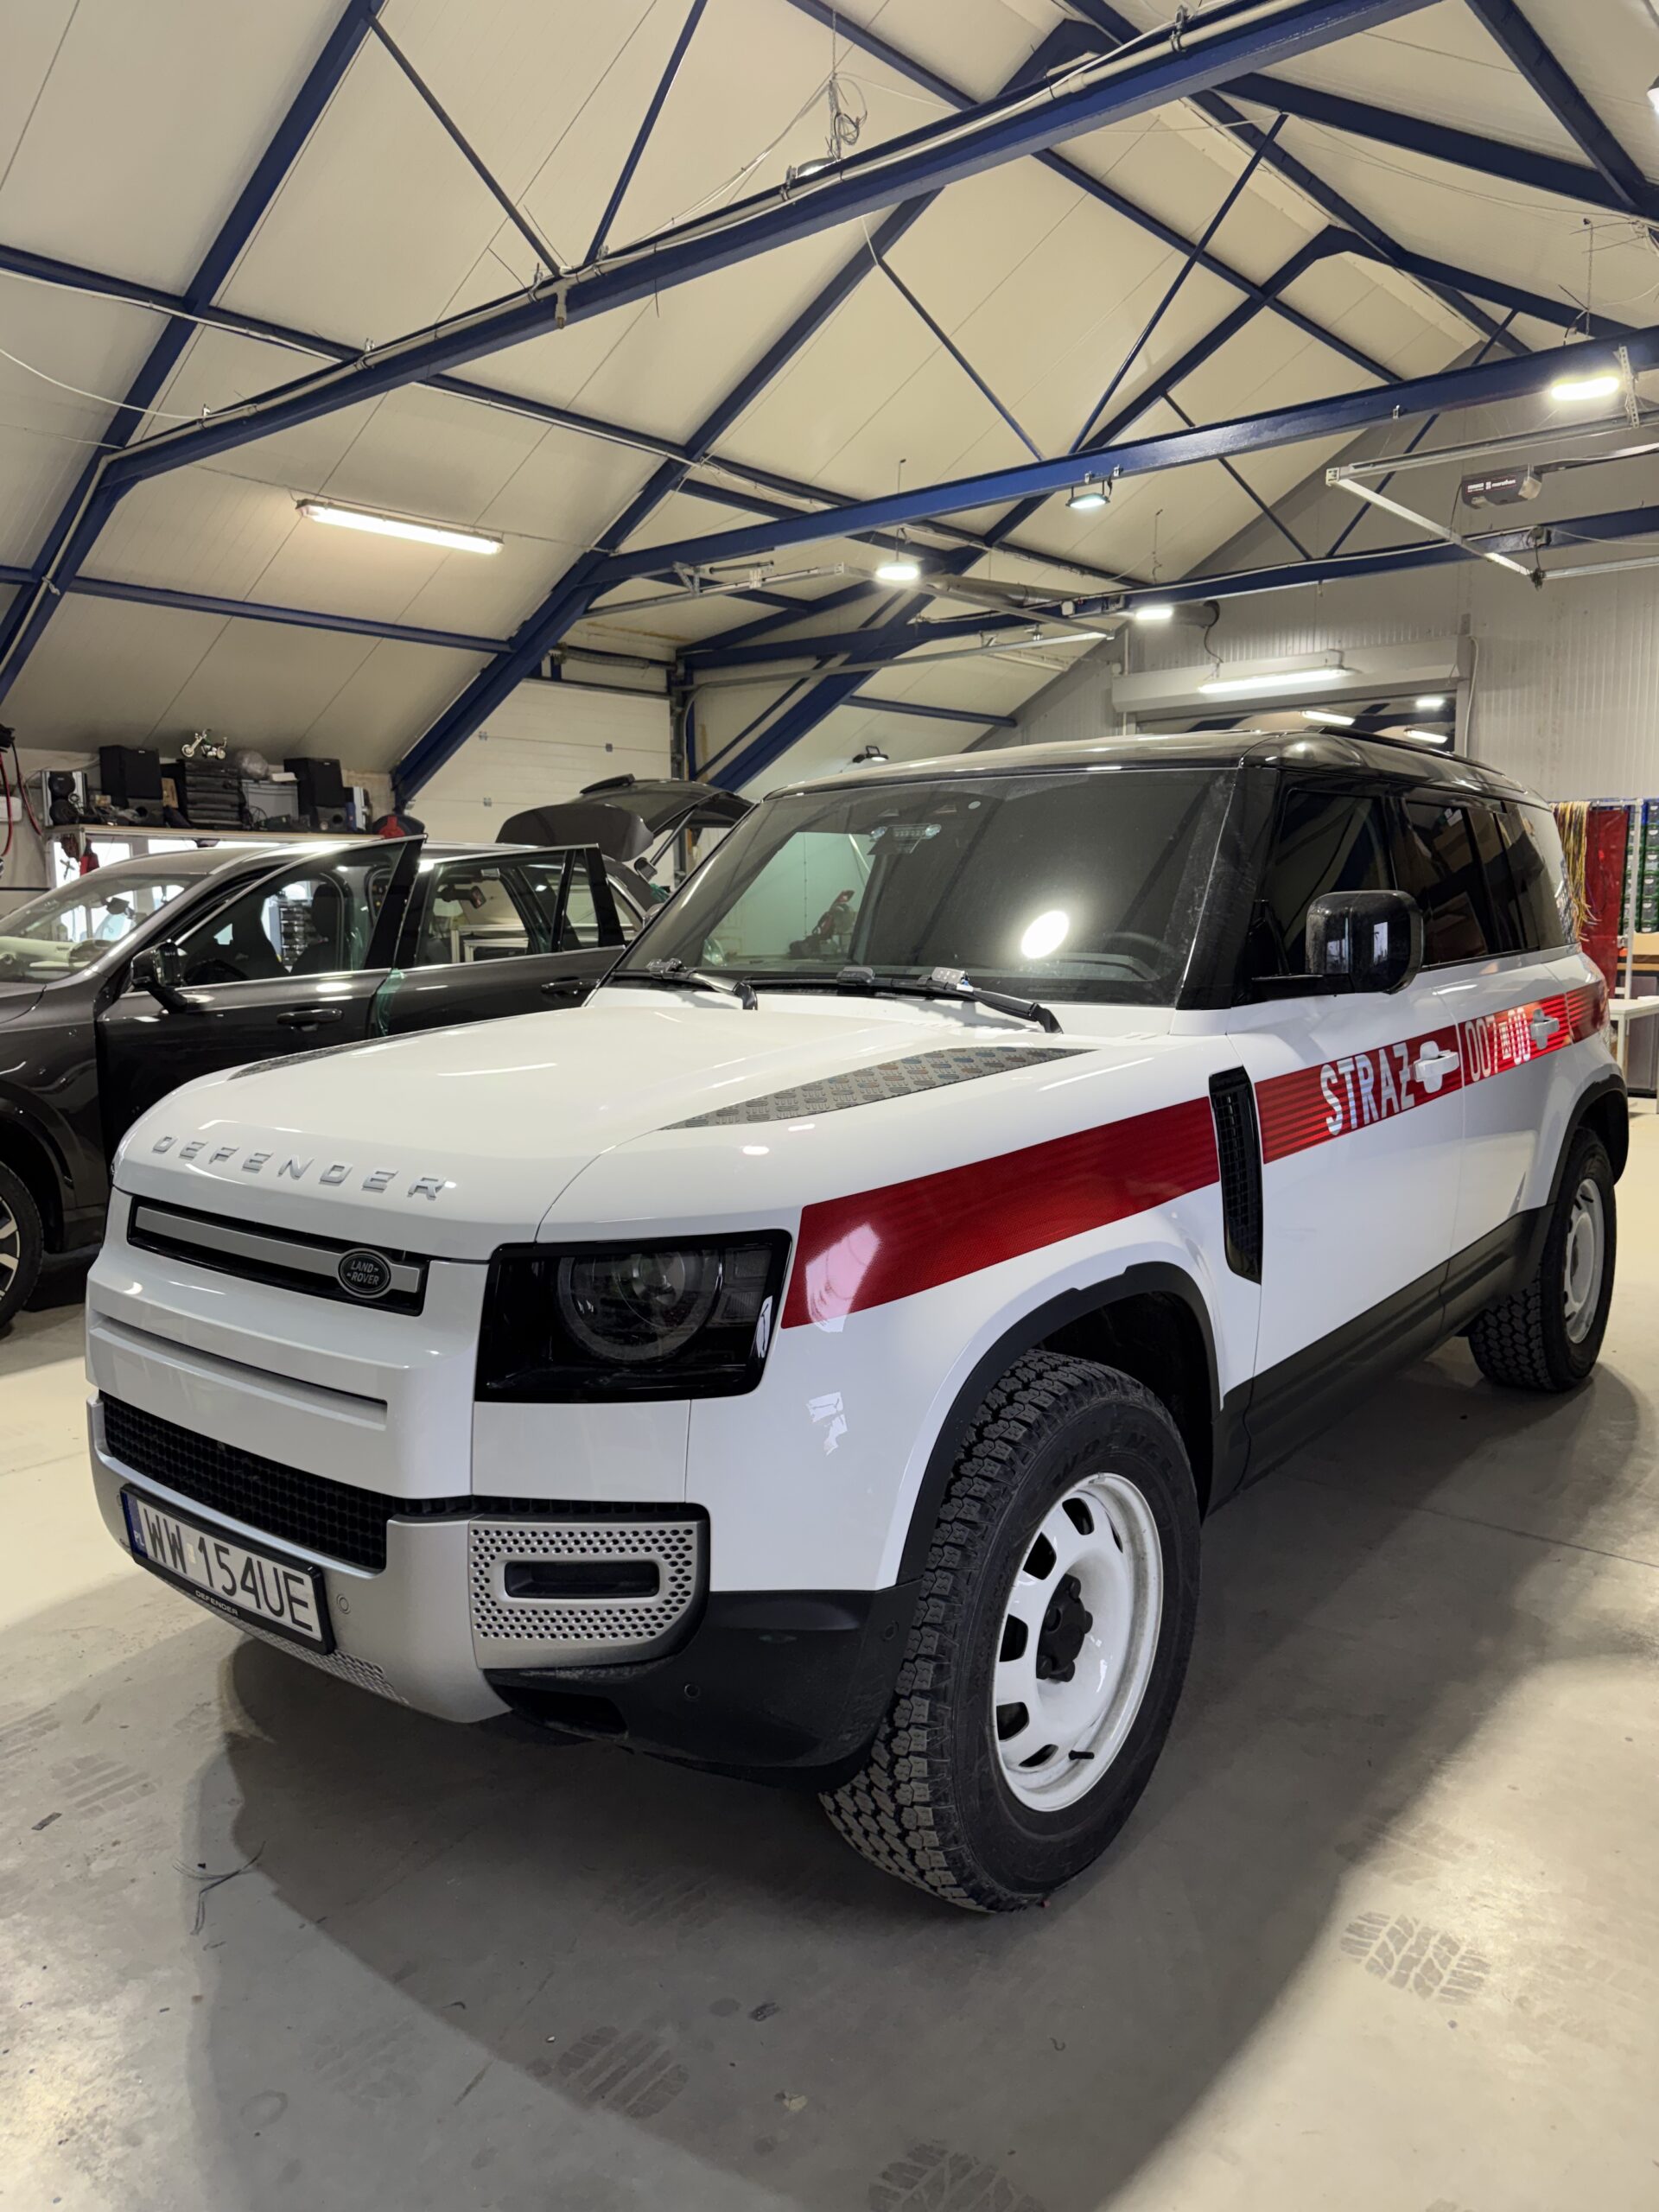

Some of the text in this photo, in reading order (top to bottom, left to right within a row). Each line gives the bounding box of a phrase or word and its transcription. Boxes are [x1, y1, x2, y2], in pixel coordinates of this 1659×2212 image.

[152, 1135, 446, 1200] DEFENDER
[132, 1529, 145, 1547] PL
[143, 1508, 314, 1632] WW 154UE
[195, 1590, 238, 1617] DEFENDER
